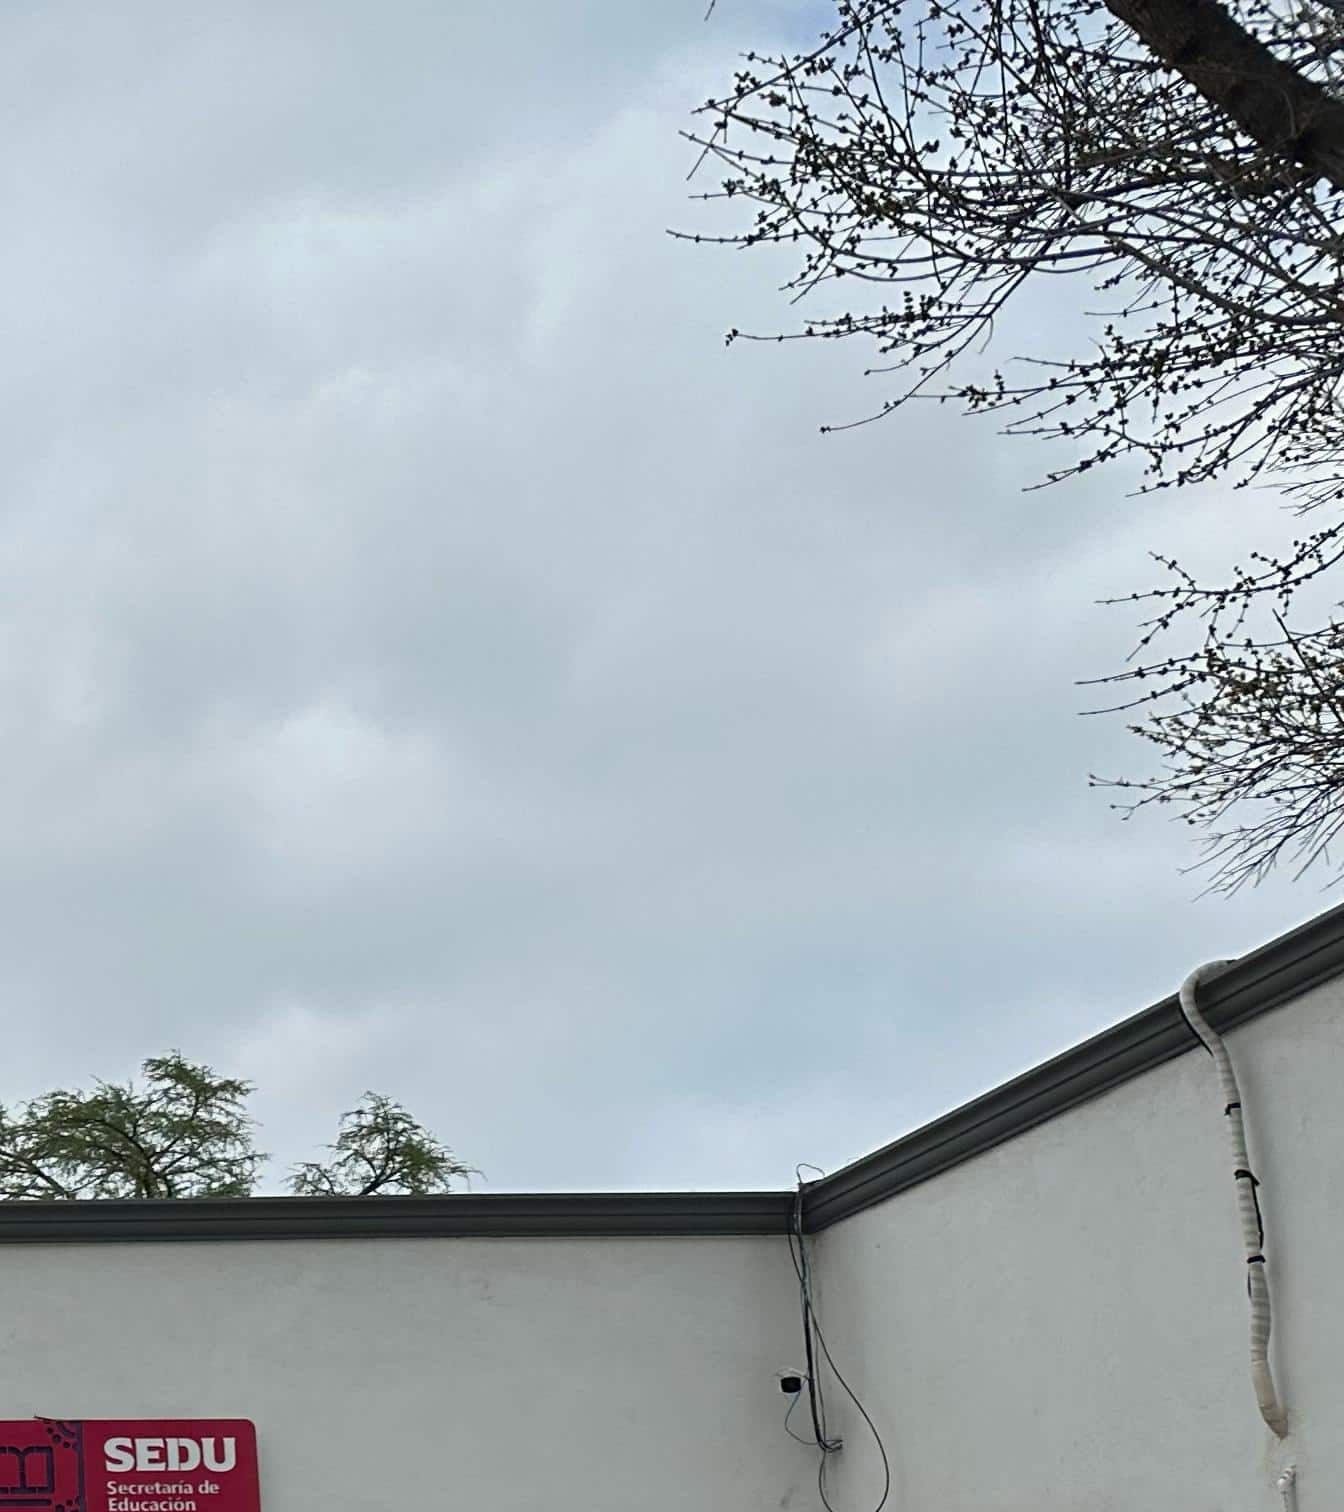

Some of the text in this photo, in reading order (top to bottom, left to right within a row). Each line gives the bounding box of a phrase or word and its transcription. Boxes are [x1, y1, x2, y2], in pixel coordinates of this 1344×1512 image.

[104, 1437, 236, 1472] SEDU
[107, 1479, 220, 1495] Secretaría de
[108, 1497, 197, 1512] Educación
